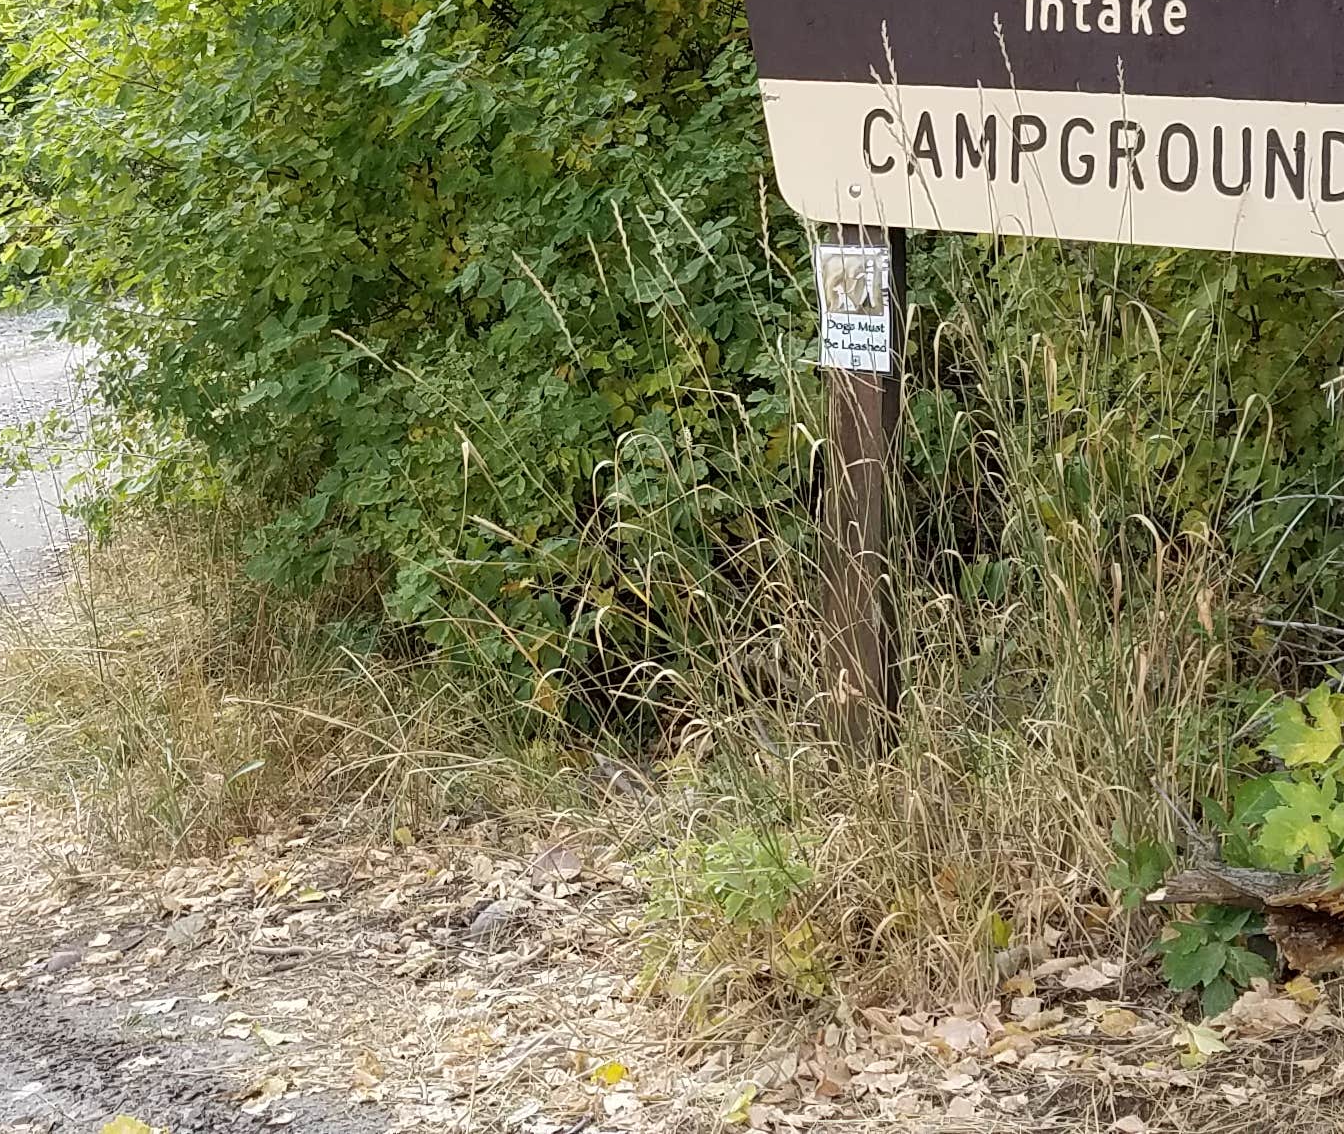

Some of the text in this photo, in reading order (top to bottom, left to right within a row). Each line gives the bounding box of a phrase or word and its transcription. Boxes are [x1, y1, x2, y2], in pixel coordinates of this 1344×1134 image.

[827, 319, 885, 334] Dogs Must
[824, 338, 887, 353] Be Leashed
